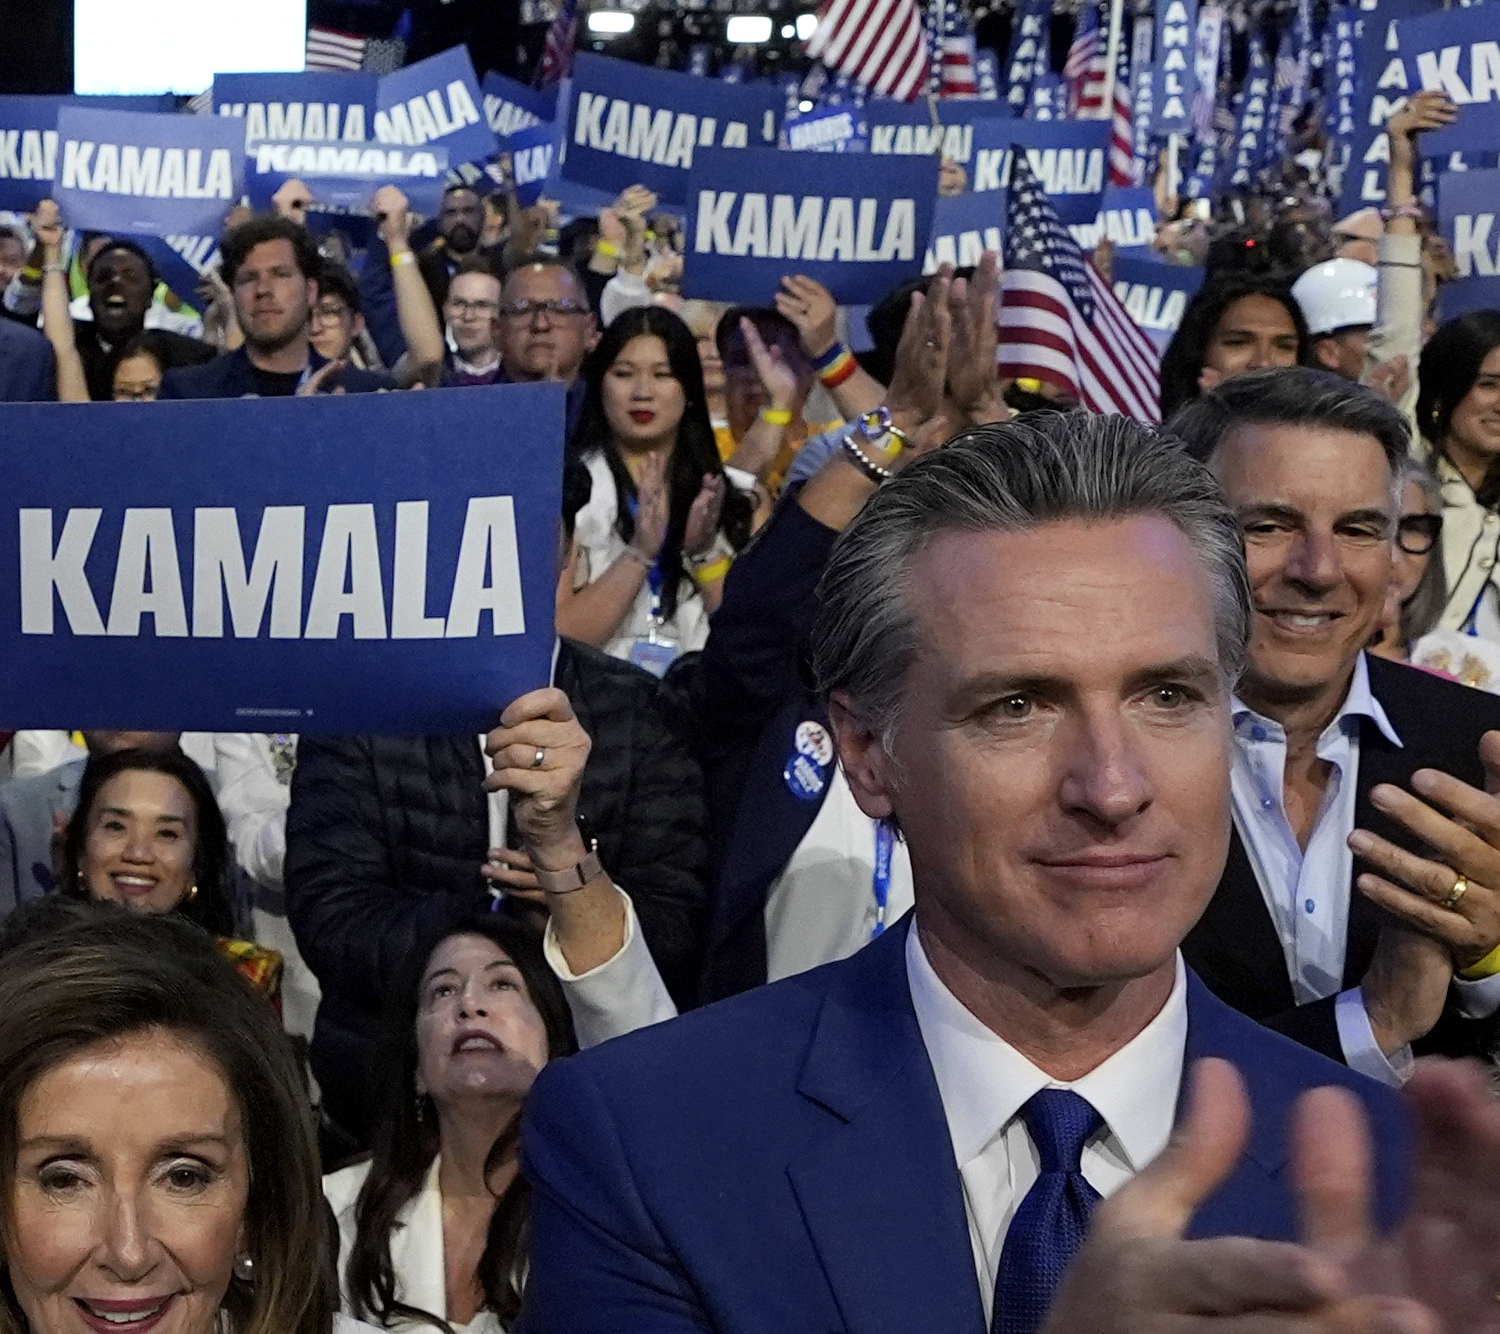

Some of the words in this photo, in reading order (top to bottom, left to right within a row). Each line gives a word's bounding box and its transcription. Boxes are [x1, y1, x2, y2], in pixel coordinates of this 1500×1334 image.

[375, 79, 480, 145] MALA
[61, 140, 232, 199] KAMALA
[975, 149, 1103, 194] KMALA
[697, 190, 916, 262] KAMALA
[19, 496, 526, 639] KAMALA
